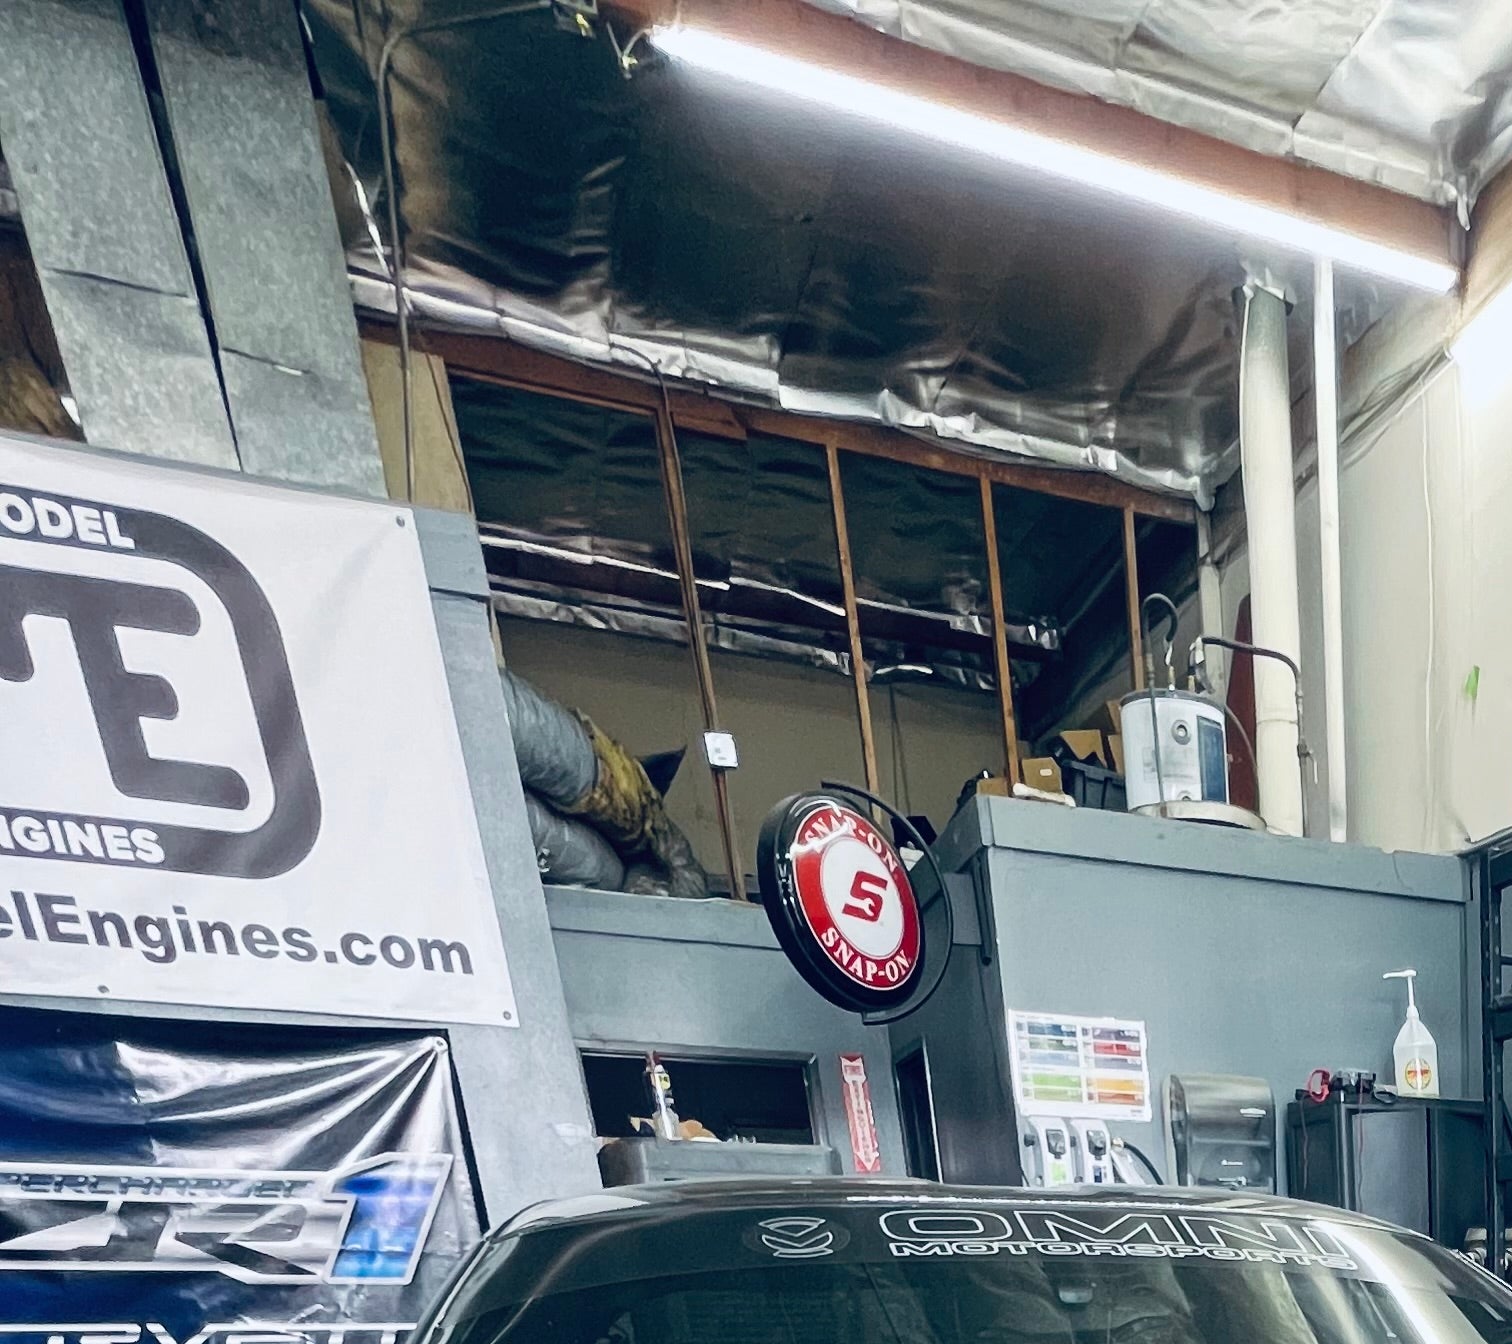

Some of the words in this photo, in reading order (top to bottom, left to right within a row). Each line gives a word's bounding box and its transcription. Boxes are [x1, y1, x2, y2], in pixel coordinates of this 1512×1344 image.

[804, 813, 898, 873] SNAP-ON
[820, 927, 912, 983] SNAP-ON
[879, 1208, 1350, 1259] OMNI
[888, 1241, 1358, 1271] MOTORSPORTS
